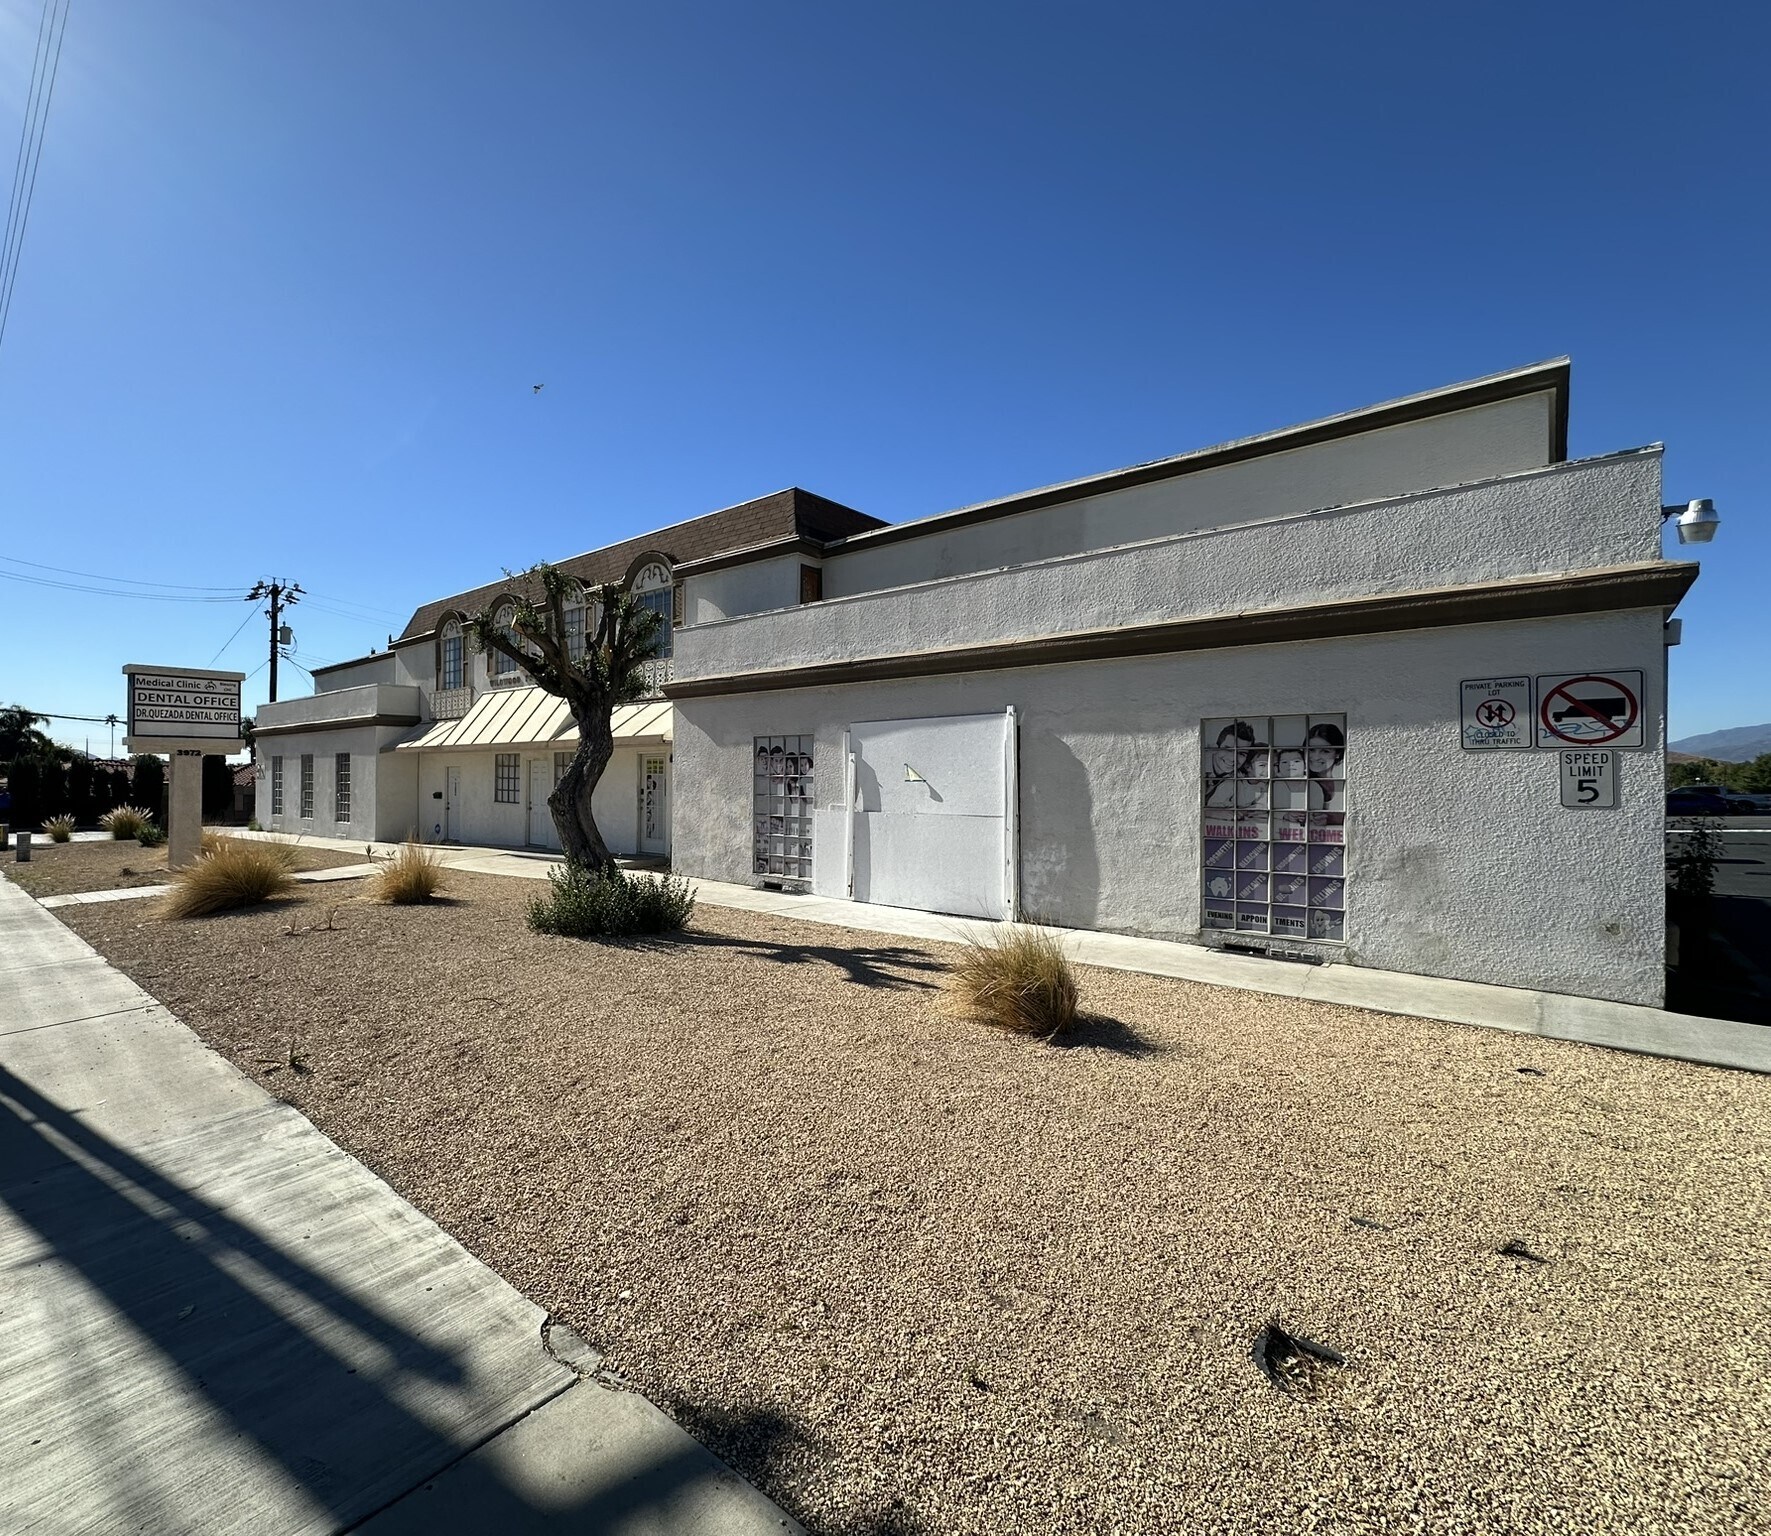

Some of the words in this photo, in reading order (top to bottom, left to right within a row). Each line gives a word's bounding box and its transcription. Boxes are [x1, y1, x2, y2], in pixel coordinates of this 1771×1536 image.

[136, 677, 174, 687] Medical
[176, 680, 201, 689] Clinic
[137, 693, 190, 704] DENTAL
[193, 696, 236, 706] OFFICE
[185, 710, 213, 721] DENTAL
[214, 712, 237, 721] OFFICE
[1565, 753, 1609, 765] SPEED
[1569, 766, 1604, 777] LIMIT
[1577, 779, 1600, 803] 5
[1206, 840, 1233, 866] COSMETIC
[1312, 846, 1343, 874] CROWNS
[1239, 874, 1266, 898] IMPLANTS
[1311, 880, 1341, 905] FILLINGS
[1207, 911, 1233, 920] EVENING
